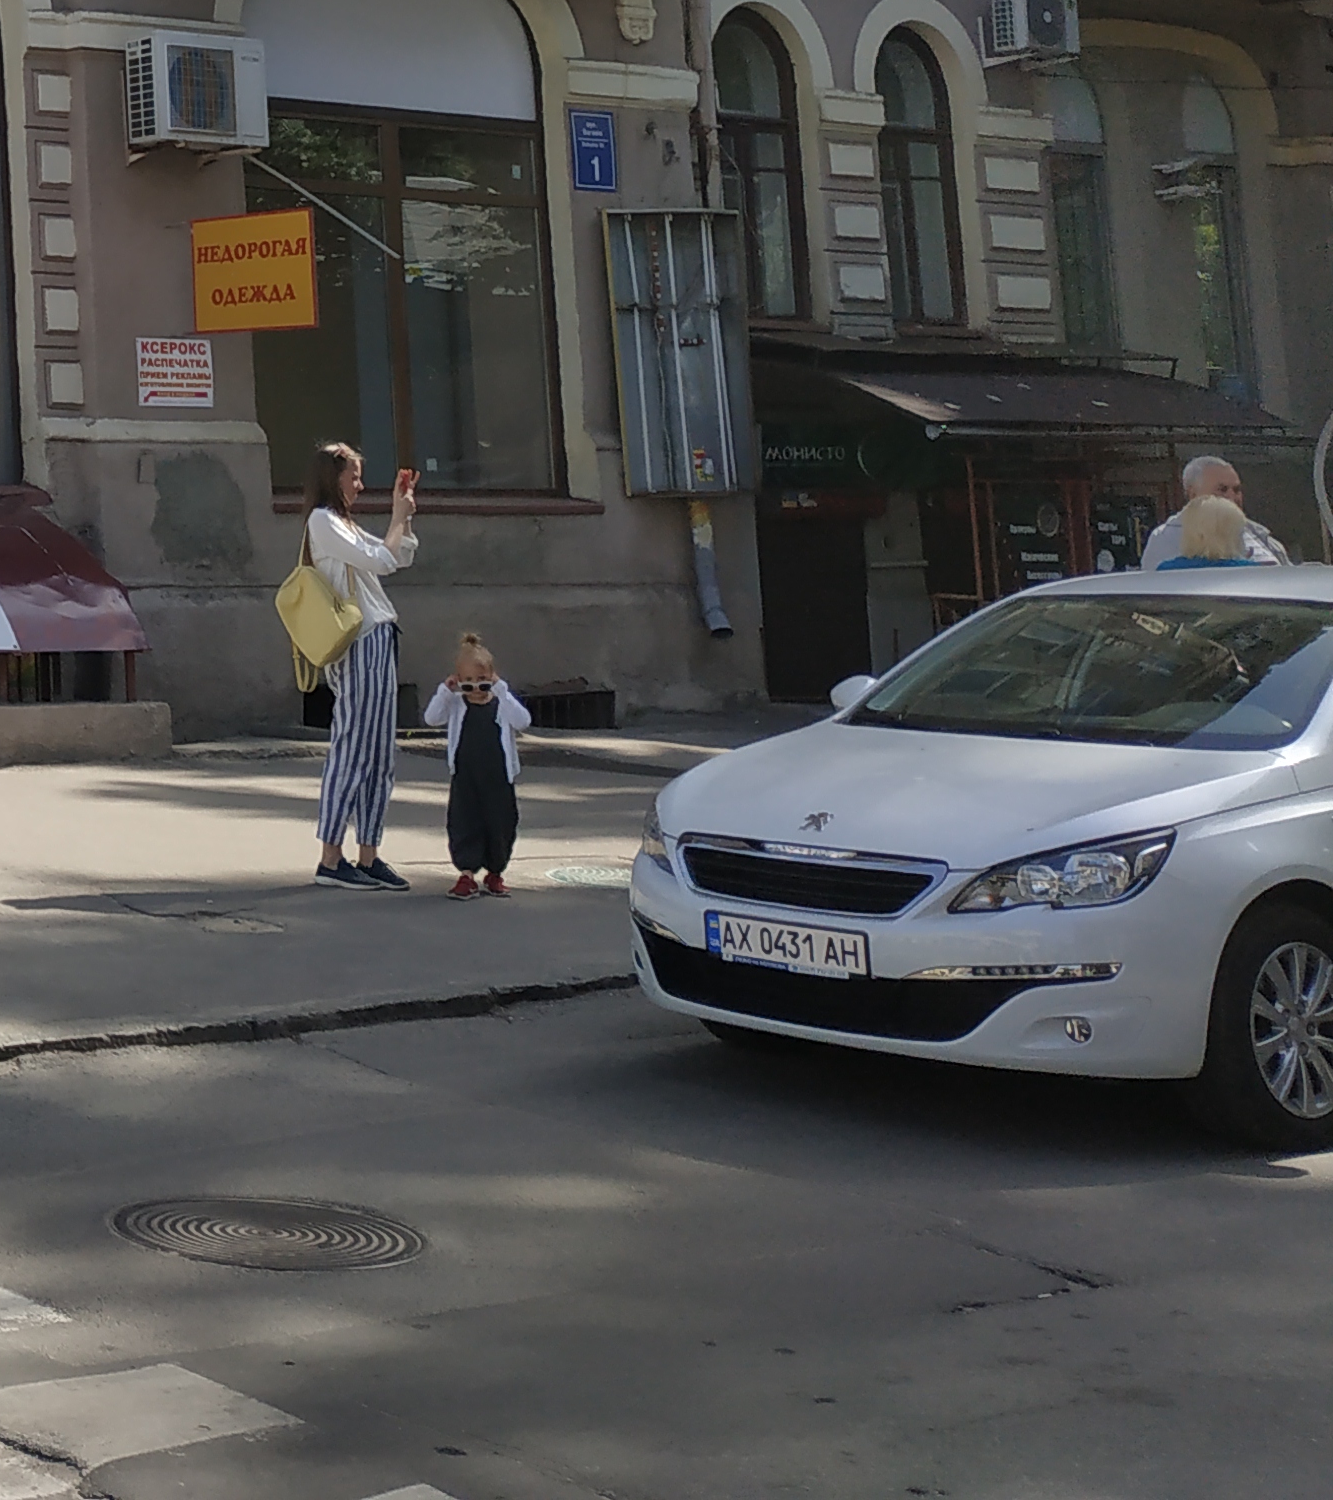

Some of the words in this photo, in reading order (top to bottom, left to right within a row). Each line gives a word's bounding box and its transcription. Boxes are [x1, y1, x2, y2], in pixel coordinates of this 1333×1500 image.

[590, 155, 600, 182] 1
[196, 237, 307, 264] НЕДОРОГАЯ
[211, 283, 296, 307] ОДЕЖДА
[140, 341, 207, 355] КСЕРОКС
[140, 358, 210, 369] РАСПЕЧАТКА
[140, 371, 169, 379] ПРИЕМ
[765, 445, 846, 461] МОНИСТО
[722, 920, 753, 953] AX
[760, 927, 815, 963] 0431
[824, 936, 860, 969] AH
